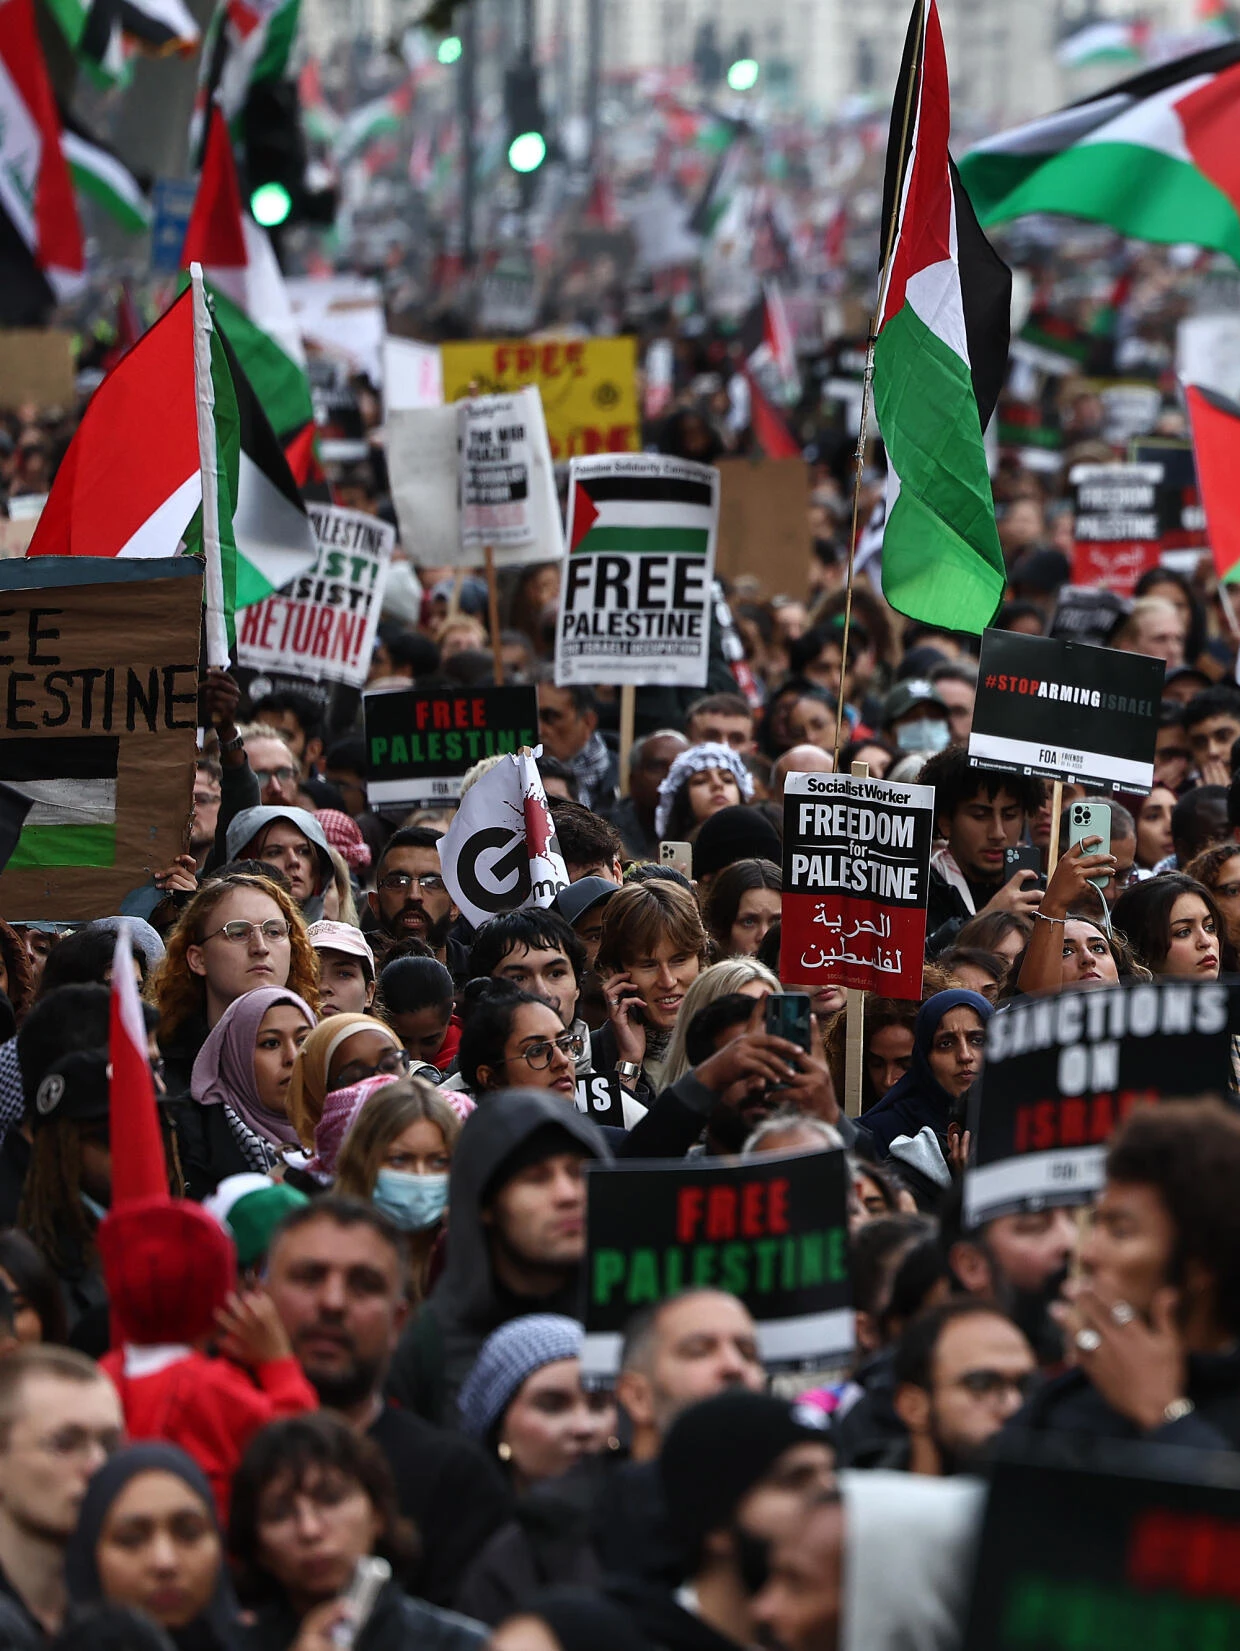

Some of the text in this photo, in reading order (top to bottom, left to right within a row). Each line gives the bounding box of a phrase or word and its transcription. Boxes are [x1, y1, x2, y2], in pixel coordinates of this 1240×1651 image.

[565, 556, 707, 611] FREE
[562, 611, 703, 639] PALESTINE
[415, 697, 488, 731] FREE
[370, 728, 533, 767] PALESTINE
[1038, 749, 1057, 765] FOA
[798, 802, 916, 849] FREEDOM
[849, 840, 869, 858] for
[791, 853, 920, 900] PALESTINE
[812, 902, 891, 939] الحرية
[800, 935, 903, 975] لفلسطين
[986, 984, 1230, 1064] SANCTIONS
[1056, 1039, 1121, 1097] ON
[675, 1176, 790, 1244] FREE
[592, 1225, 848, 1306] PALESTINE
